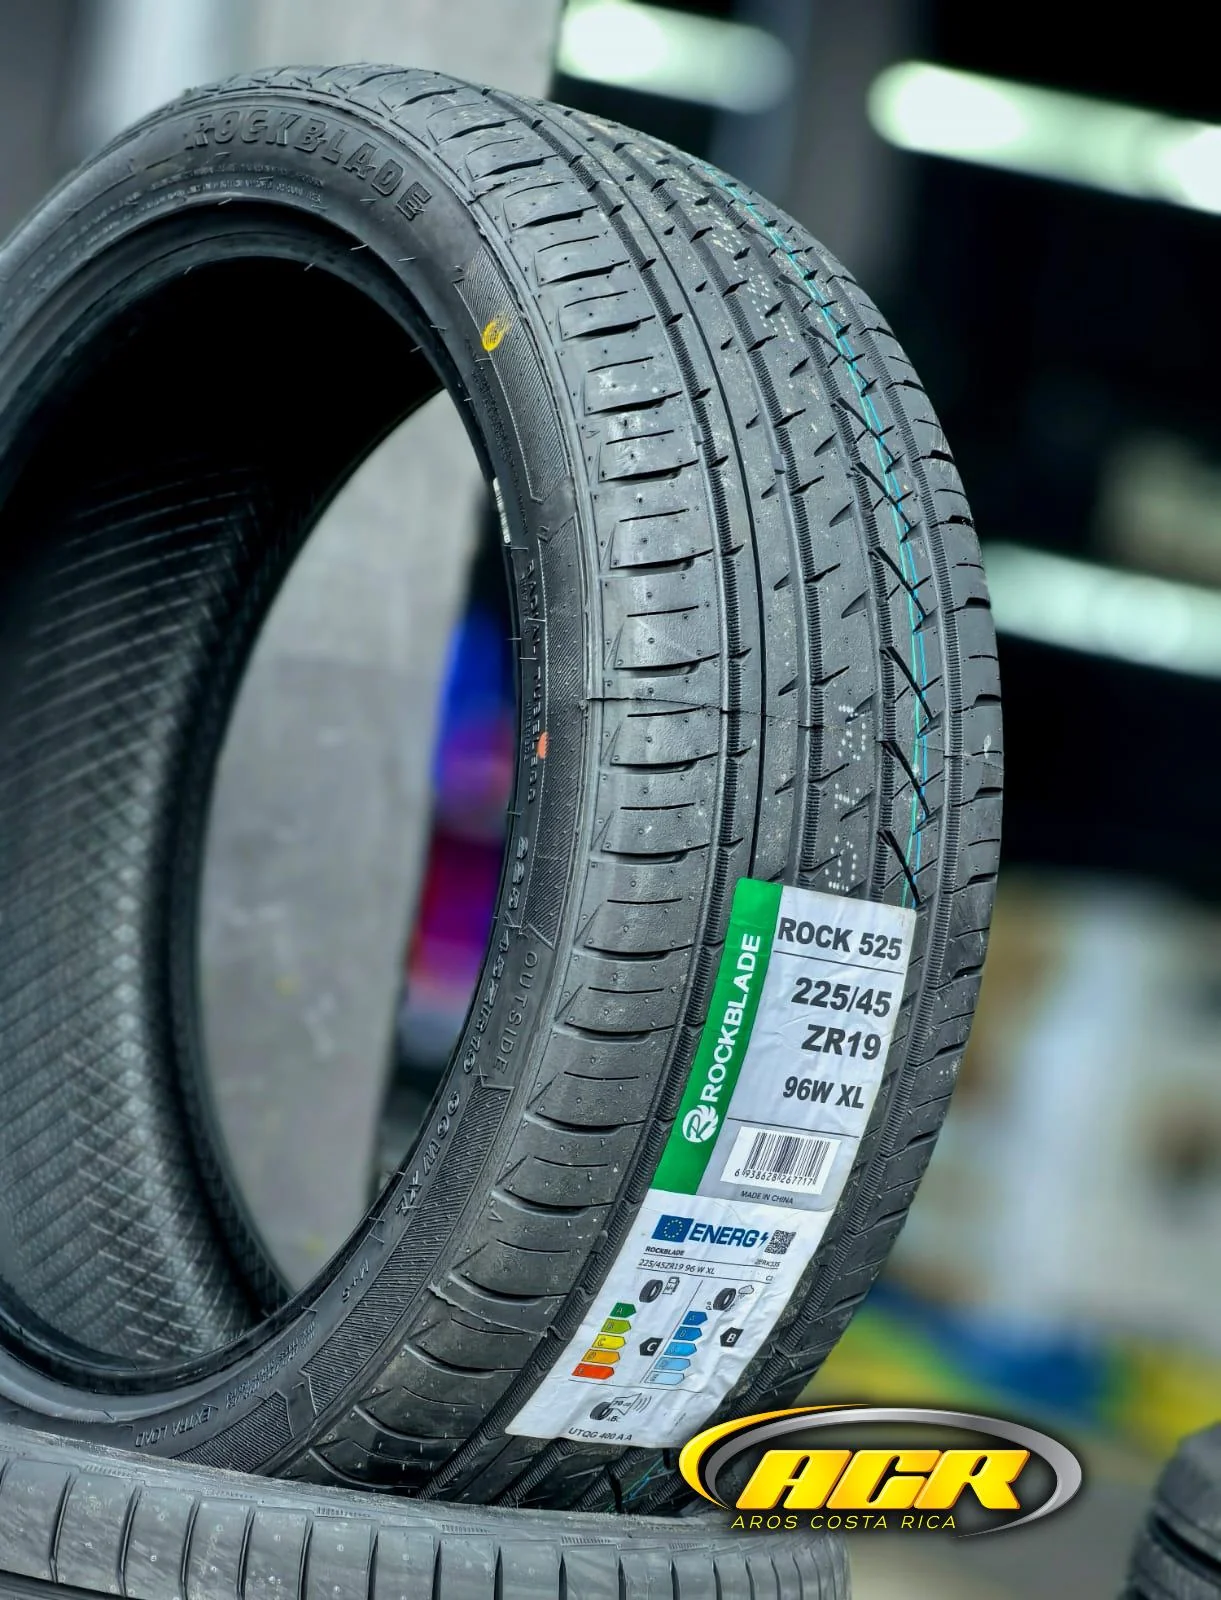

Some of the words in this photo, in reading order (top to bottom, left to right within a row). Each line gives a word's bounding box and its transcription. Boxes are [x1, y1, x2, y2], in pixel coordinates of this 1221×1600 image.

[184, 110, 432, 221] ROCKBLADE
[777, 917, 852, 952] ROCK
[858, 932, 903, 961] 525
[791, 977, 893, 1018] 225/45
[493, 951, 538, 1075] OUTSIDE
[700, 933, 761, 1103] ROCKBLADE
[801, 1024, 883, 1061] ZR19
[782, 1075, 835, 1104] 96W
[836, 1085, 866, 1110] XL
[741, 1190, 761, 1200] MADE
[762, 1193, 771, 1201] IN
[771, 1195, 793, 1204] CHINA
[688, 1222, 760, 1248] ENERG
[645, 1246, 685, 1256] ROCKBLADE
[638, 1258, 684, 1271] 225/45ZR19
[685, 1264, 696, 1273] 96
[705, 1266, 716, 1275] XL
[647, 1342, 656, 1352] C
[726, 1332, 736, 1343] B
[568, 1427, 597, 1439] UTQG
